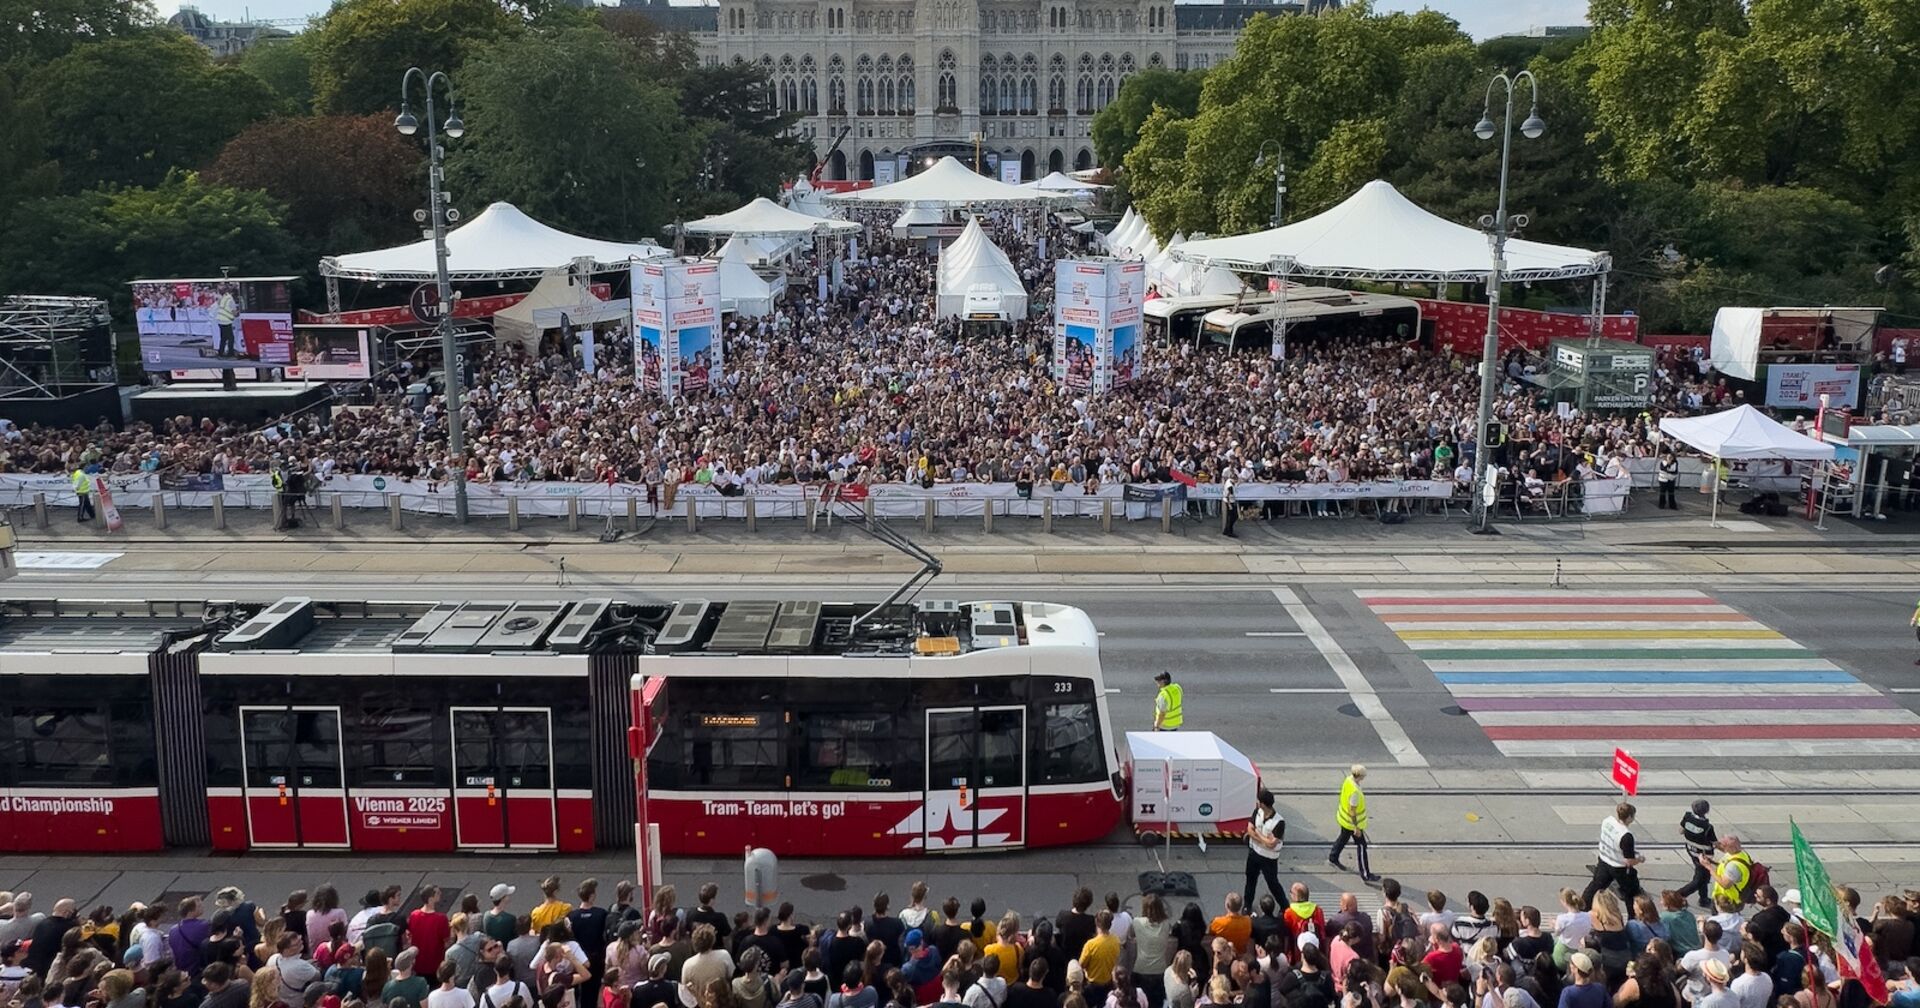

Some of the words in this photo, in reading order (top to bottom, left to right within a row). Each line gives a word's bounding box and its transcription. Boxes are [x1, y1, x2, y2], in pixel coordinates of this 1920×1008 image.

[1634, 378, 1648, 393] P
[545, 486, 583, 494] SIEMENS
[1054, 682, 1073, 693] 333
[12, 797, 114, 815] Championship
[354, 797, 405, 812] Vienna
[408, 797, 447, 813] 2025
[702, 800, 788, 818] Tram-Team,
[789, 800, 818, 816] let's
[822, 801, 845, 820] go!
[382, 817, 411, 825] WIENER
